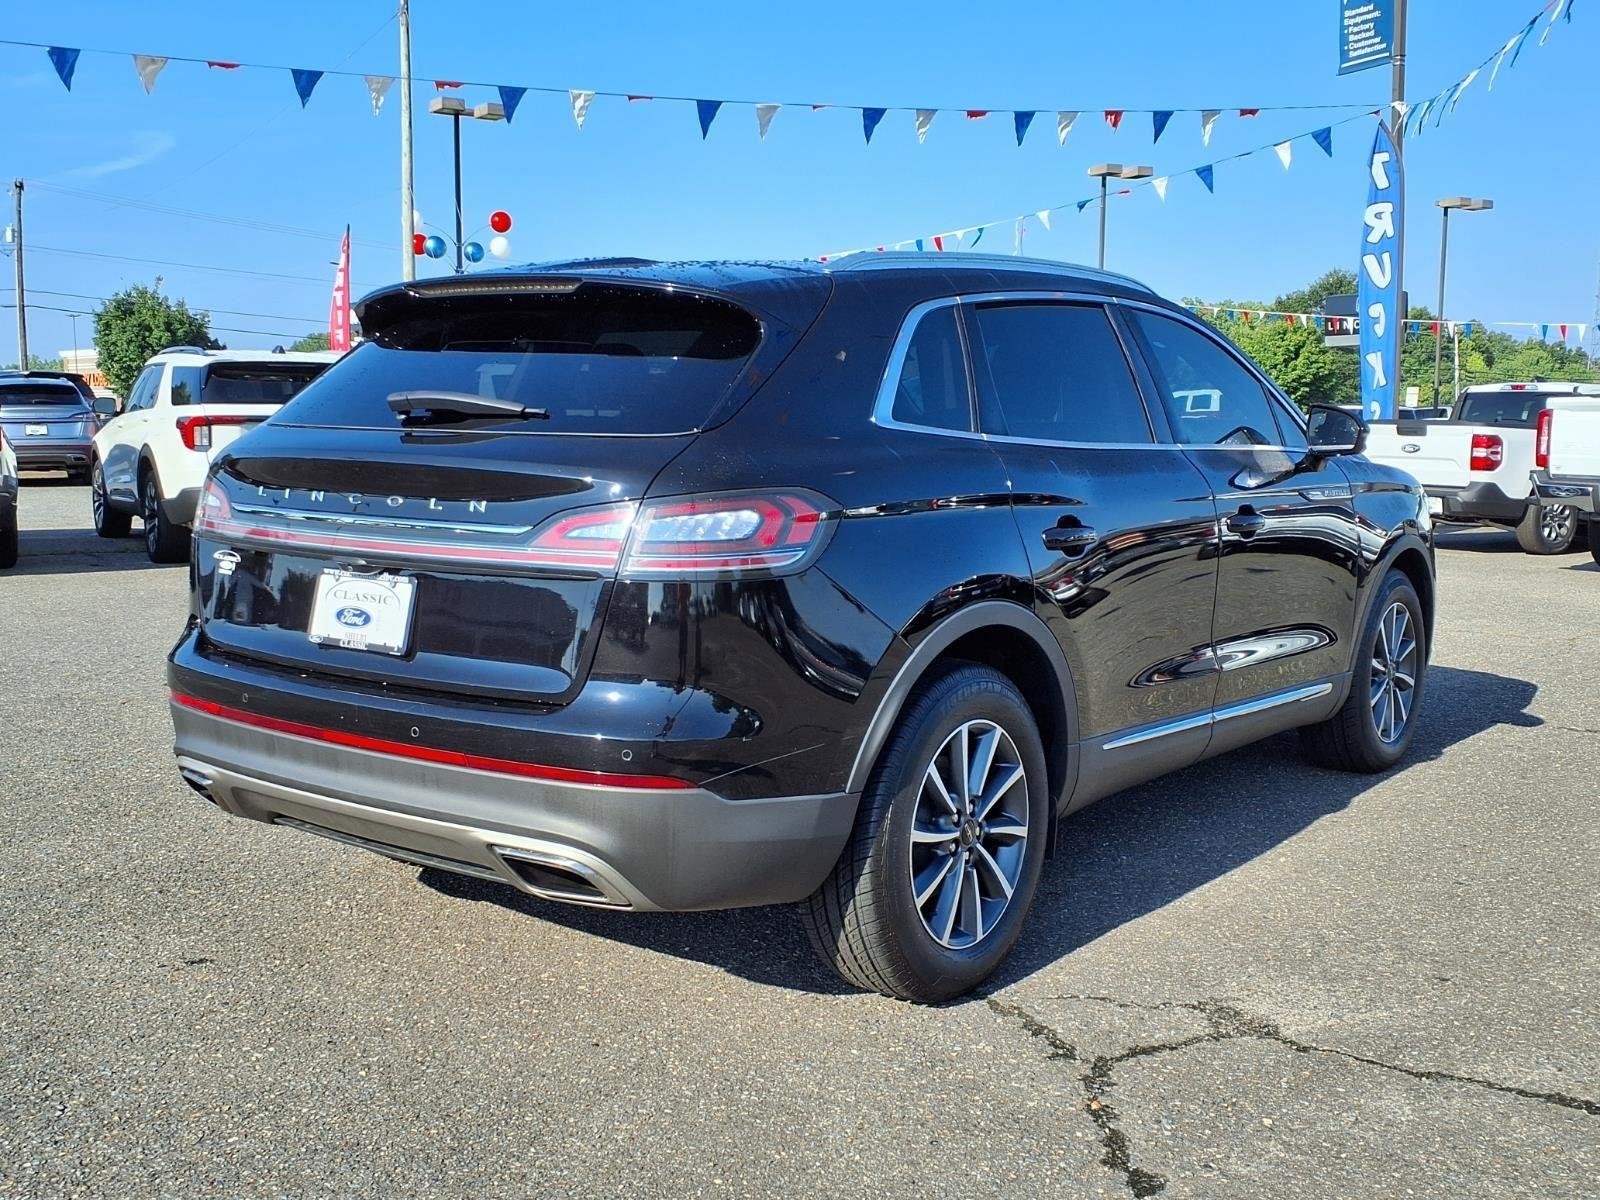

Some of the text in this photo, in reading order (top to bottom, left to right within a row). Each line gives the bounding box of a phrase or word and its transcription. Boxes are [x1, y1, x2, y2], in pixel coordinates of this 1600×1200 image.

[1344, 3, 1374, 17] Standard
[1344, 10, 1382, 26] Equipment:
[1349, 22, 1375, 34] Factory
[1349, 29, 1375, 42] Backed
[1349, 36, 1382, 50] Customer
[1349, 43, 1387, 57] Satisfaction
[258, 485, 487, 513] LINCOLN
[333, 589, 393, 606] CLASSIC
[340, 607, 367, 626] Ford
